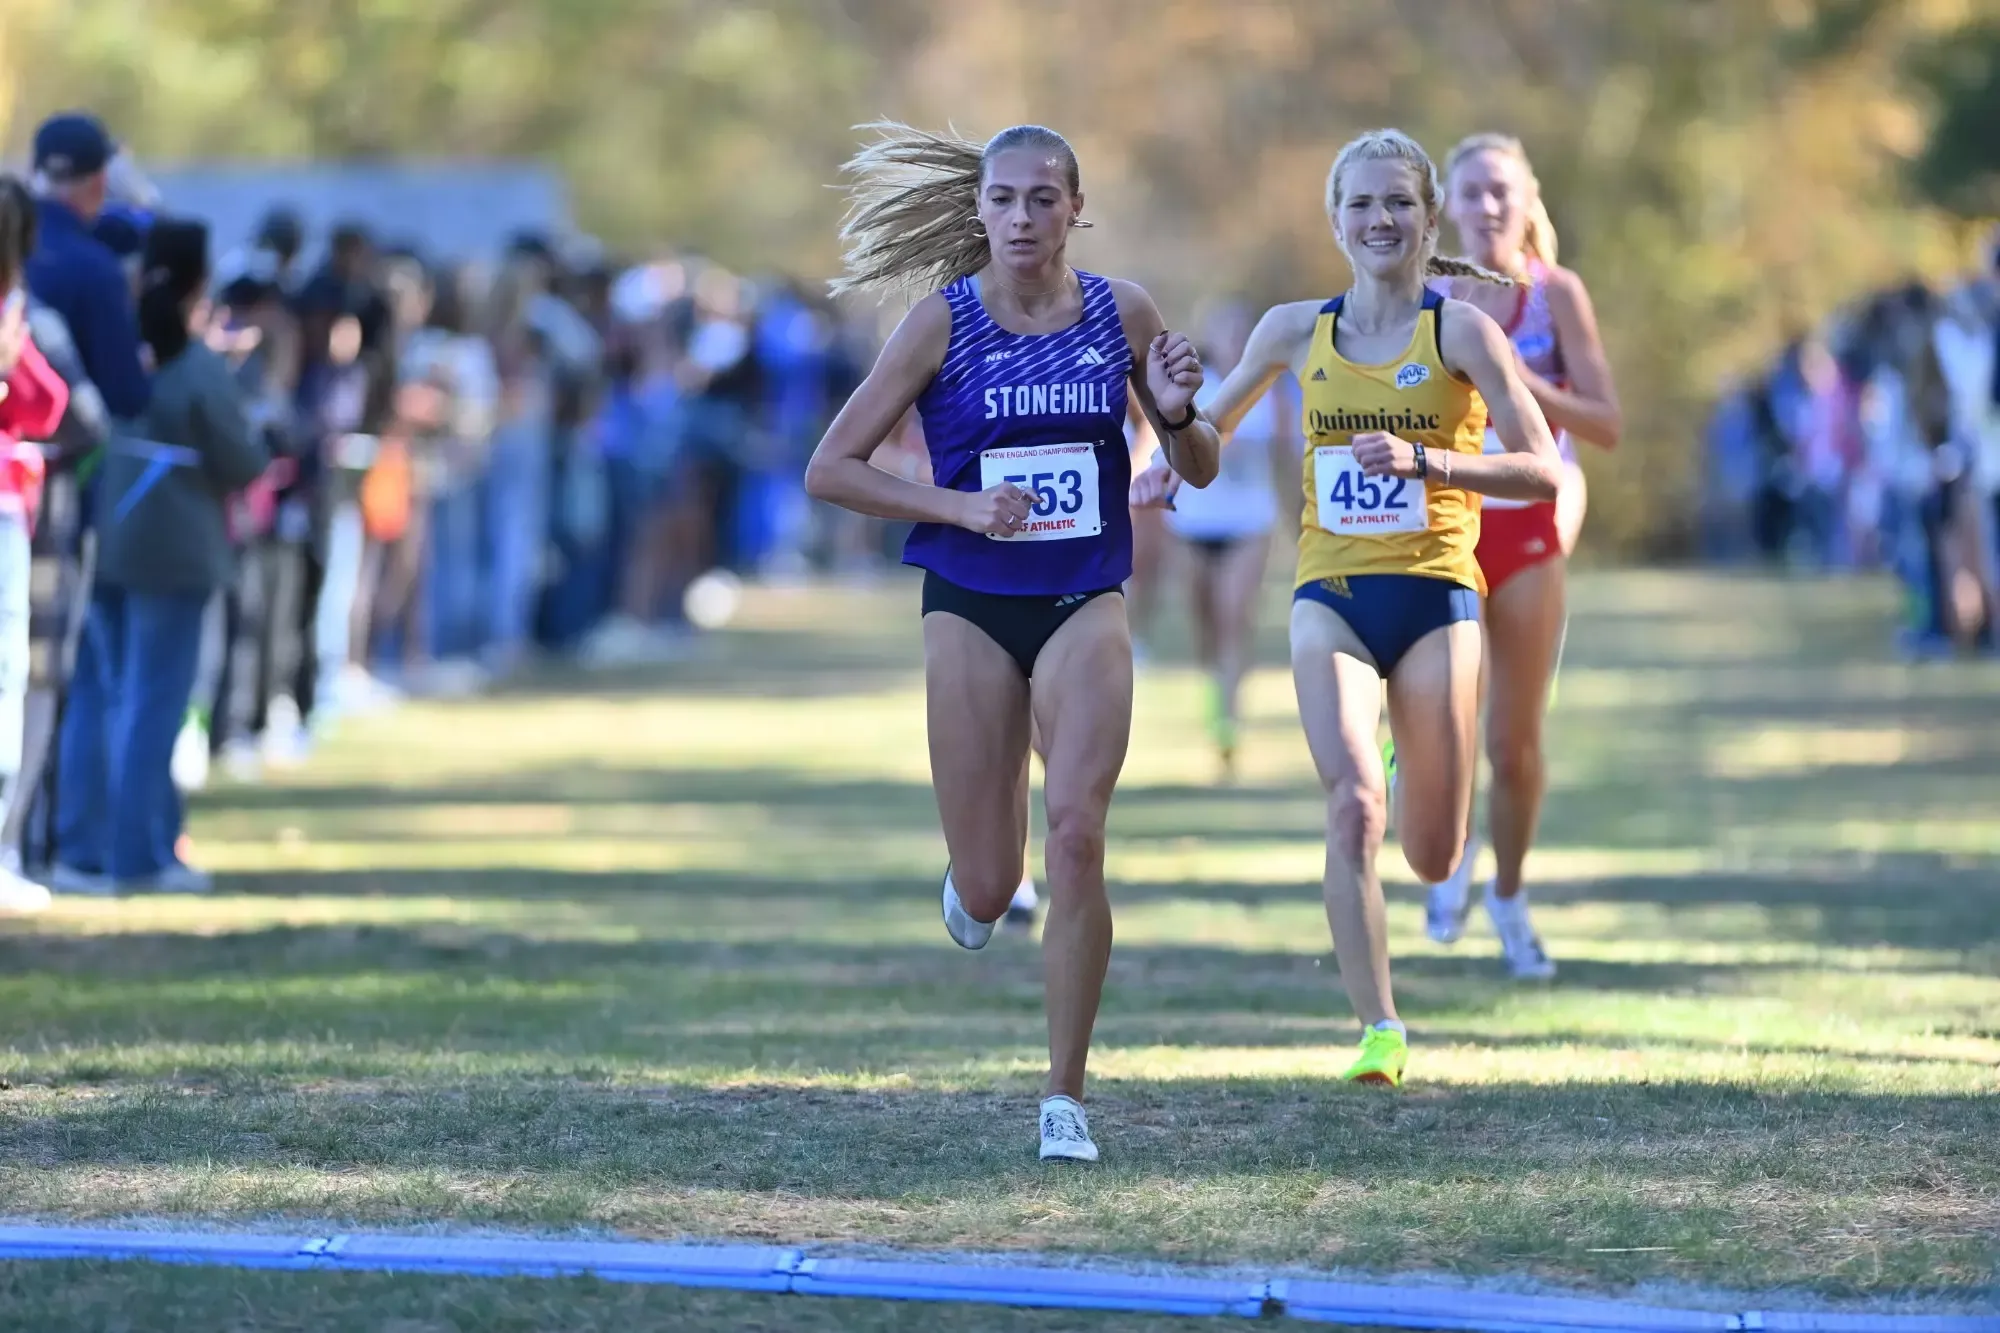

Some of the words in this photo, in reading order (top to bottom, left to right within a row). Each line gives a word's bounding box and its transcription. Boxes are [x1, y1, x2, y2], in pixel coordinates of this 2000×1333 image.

[985, 350, 1011, 363] NEC
[984, 382, 1111, 420] STONEHILL
[1309, 407, 1440, 436] Quinnipiac
[1006, 449, 1038, 459] ENGLAND
[1038, 446, 1088, 456] CHAMPIONSHIPS
[1003, 469, 1083, 517] 53
[1330, 470, 1409, 510] 452
[1030, 518, 1076, 531] ATHLETIC
[1355, 513, 1400, 525] ATHLETIC
